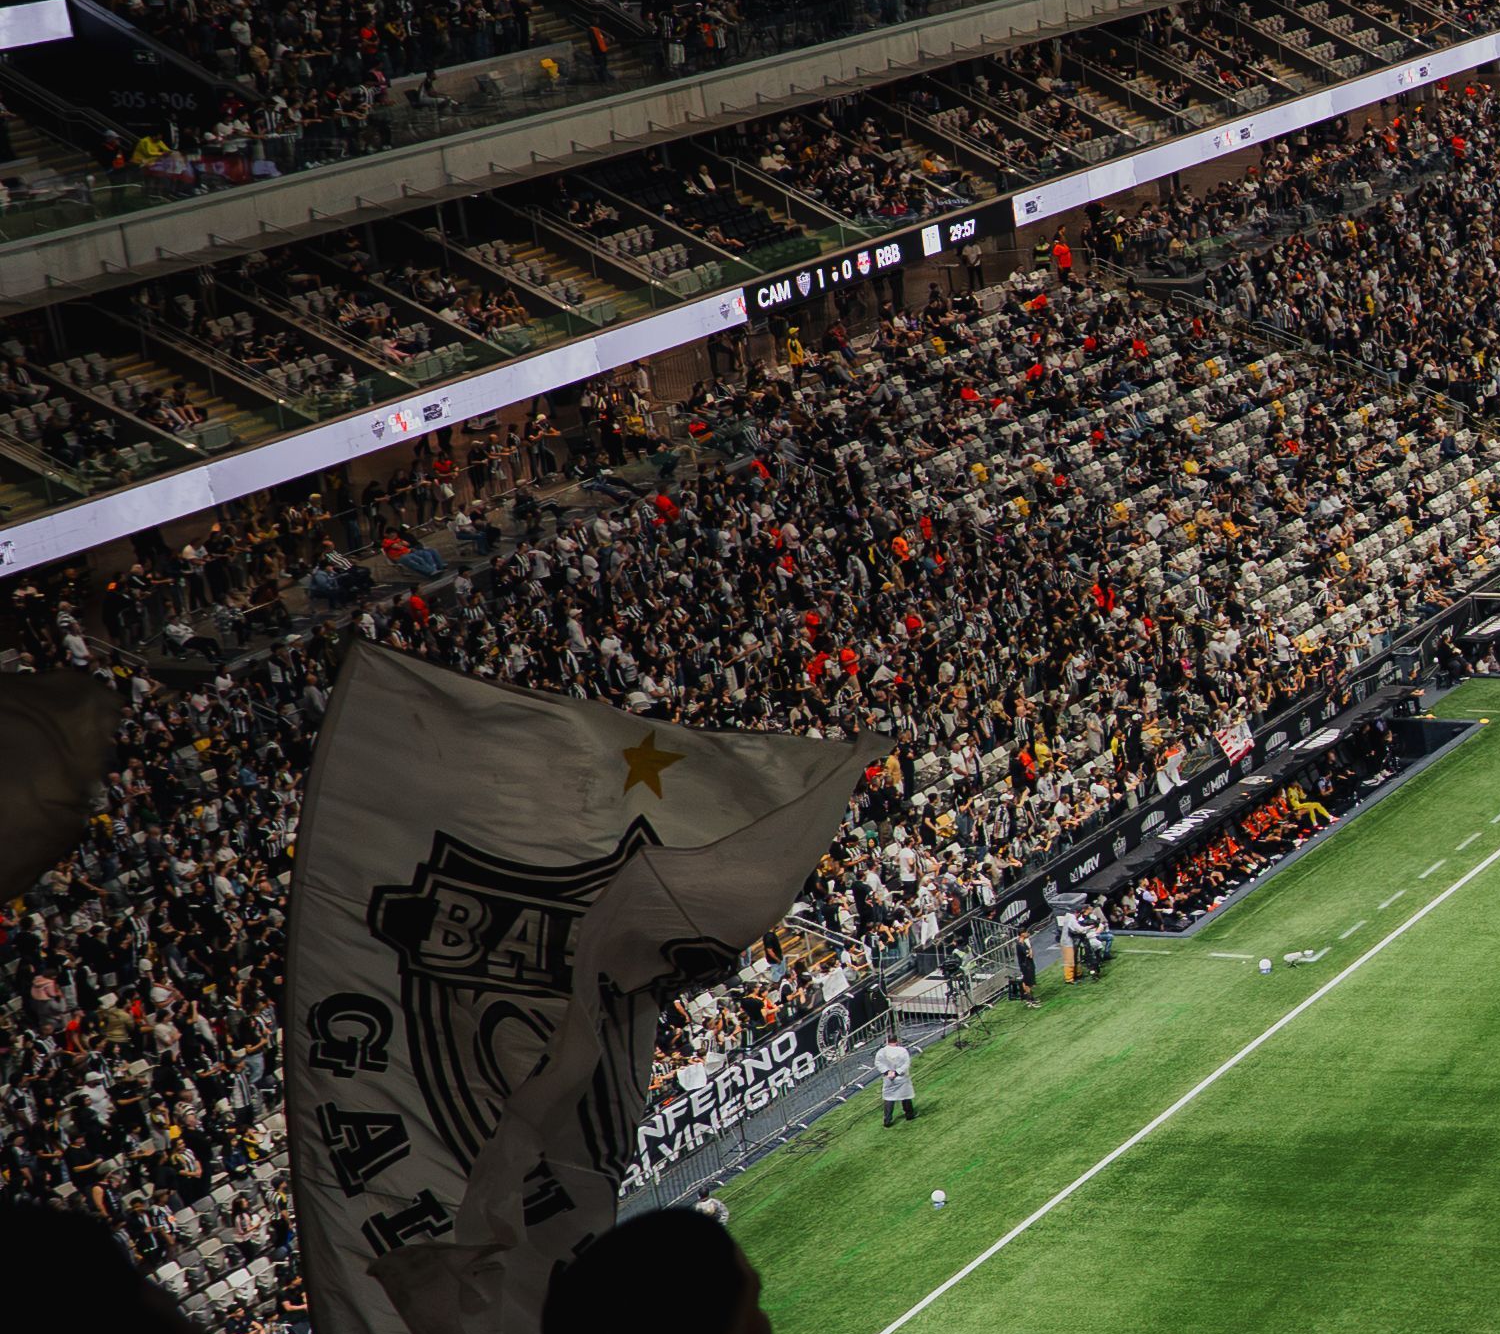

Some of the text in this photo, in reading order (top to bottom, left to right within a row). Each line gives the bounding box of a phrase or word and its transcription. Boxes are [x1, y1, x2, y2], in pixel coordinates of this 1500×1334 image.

[109, 90, 146, 108] 305
[950, 219, 976, 242] 29:57
[757, 243, 901, 308] CAM 1 0 RBB
[1210, 769, 1230, 794] MRV
[1078, 852, 1101, 879] MRV
[637, 1031, 798, 1157] NFERNO
